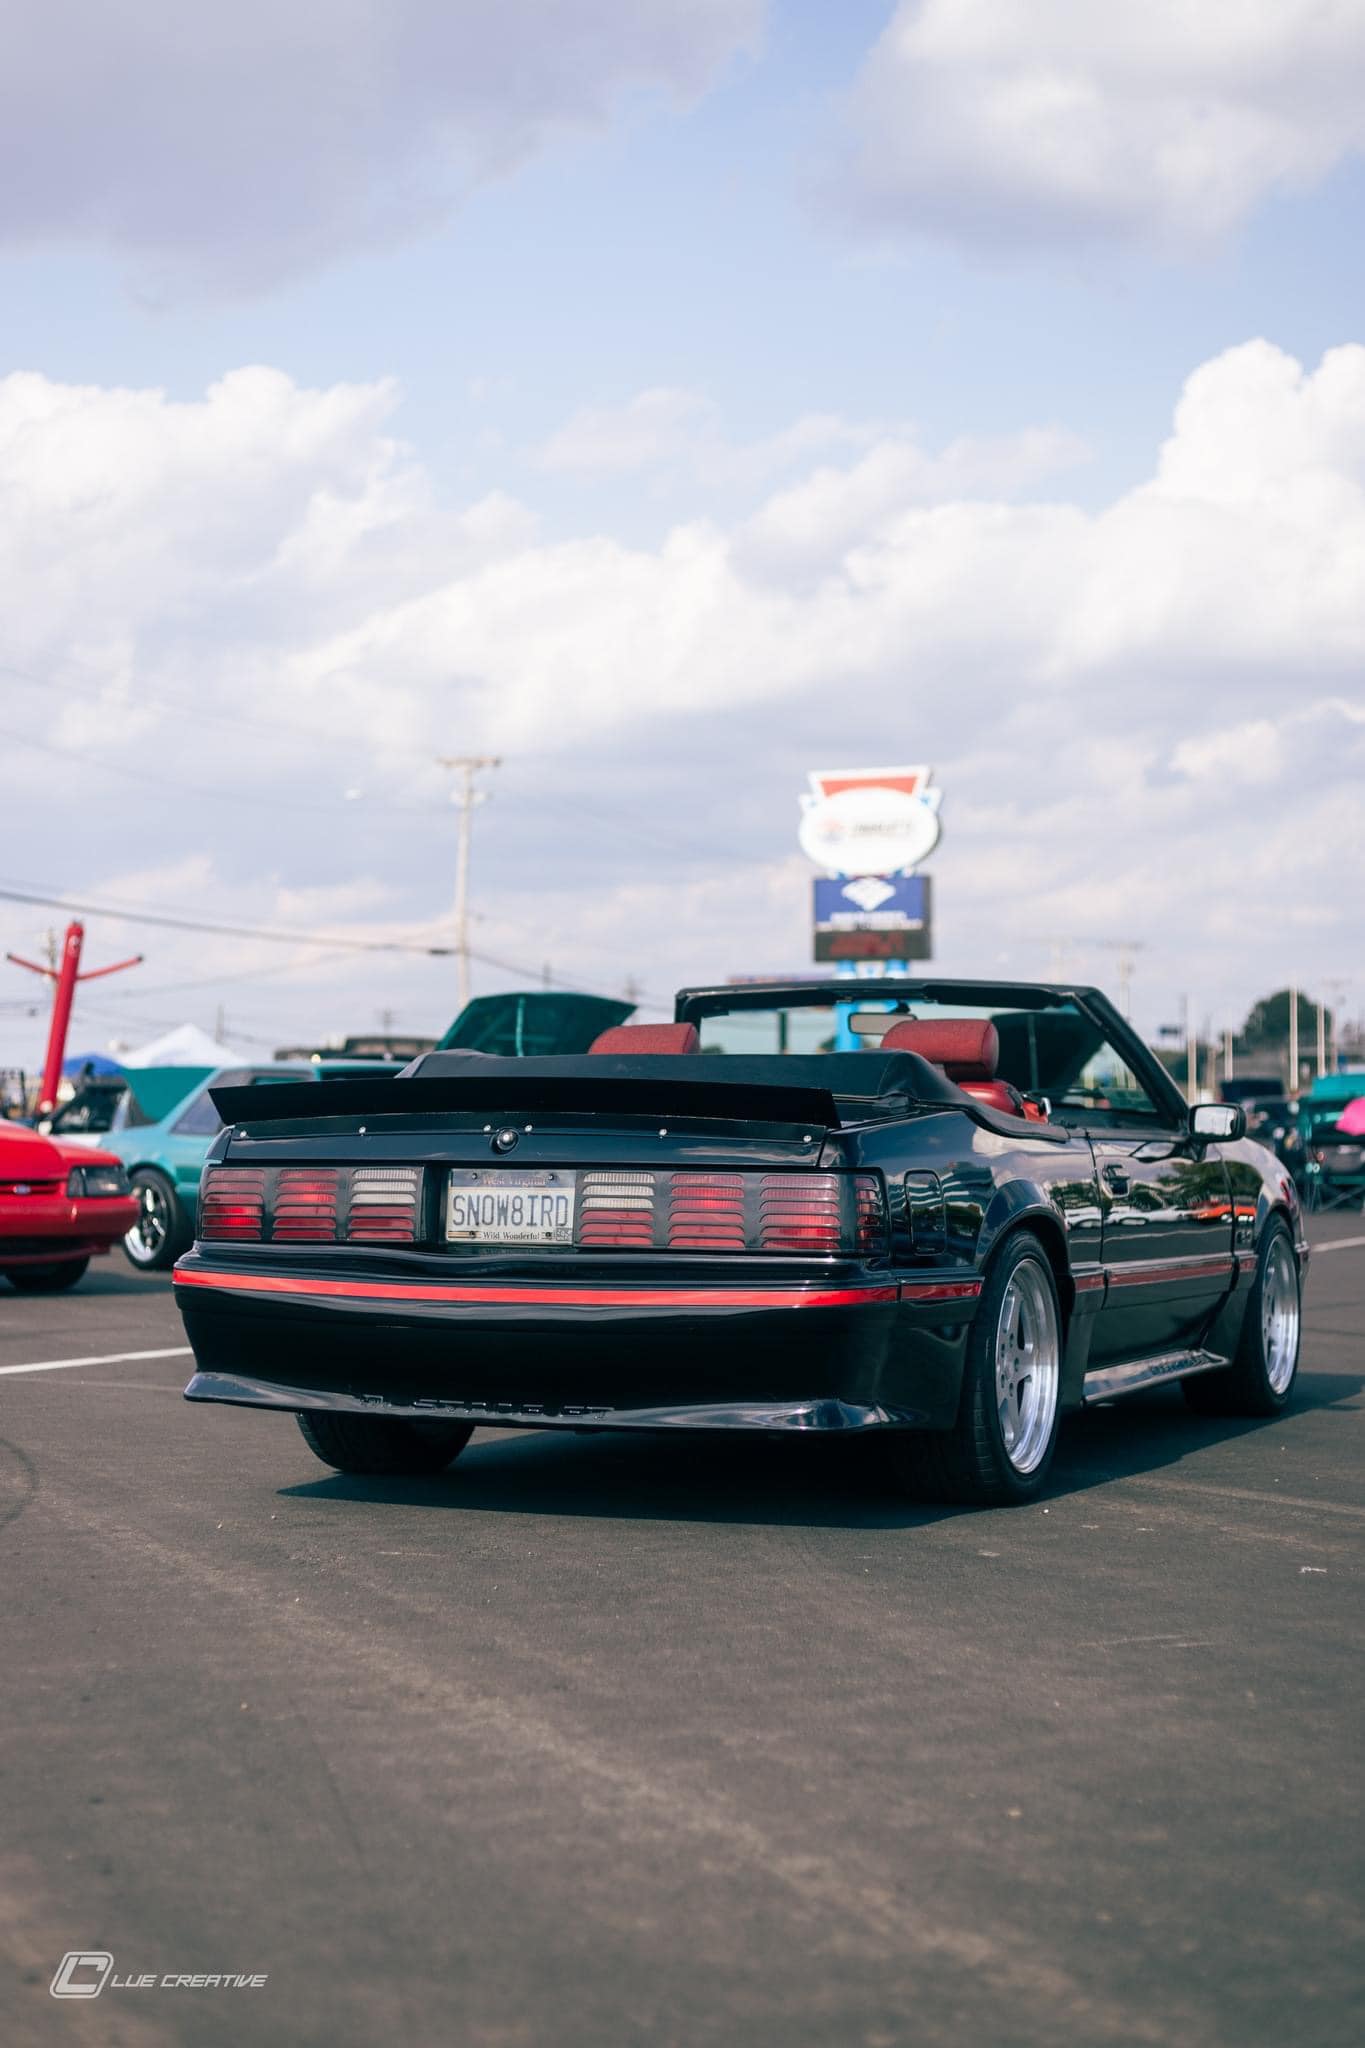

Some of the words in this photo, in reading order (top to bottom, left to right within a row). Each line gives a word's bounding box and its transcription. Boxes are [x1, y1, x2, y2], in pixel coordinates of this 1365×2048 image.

[483, 1174, 505, 1185] West
[452, 1194, 569, 1226] SNOW8IRD
[502, 1231, 540, 1240] Wonderful
